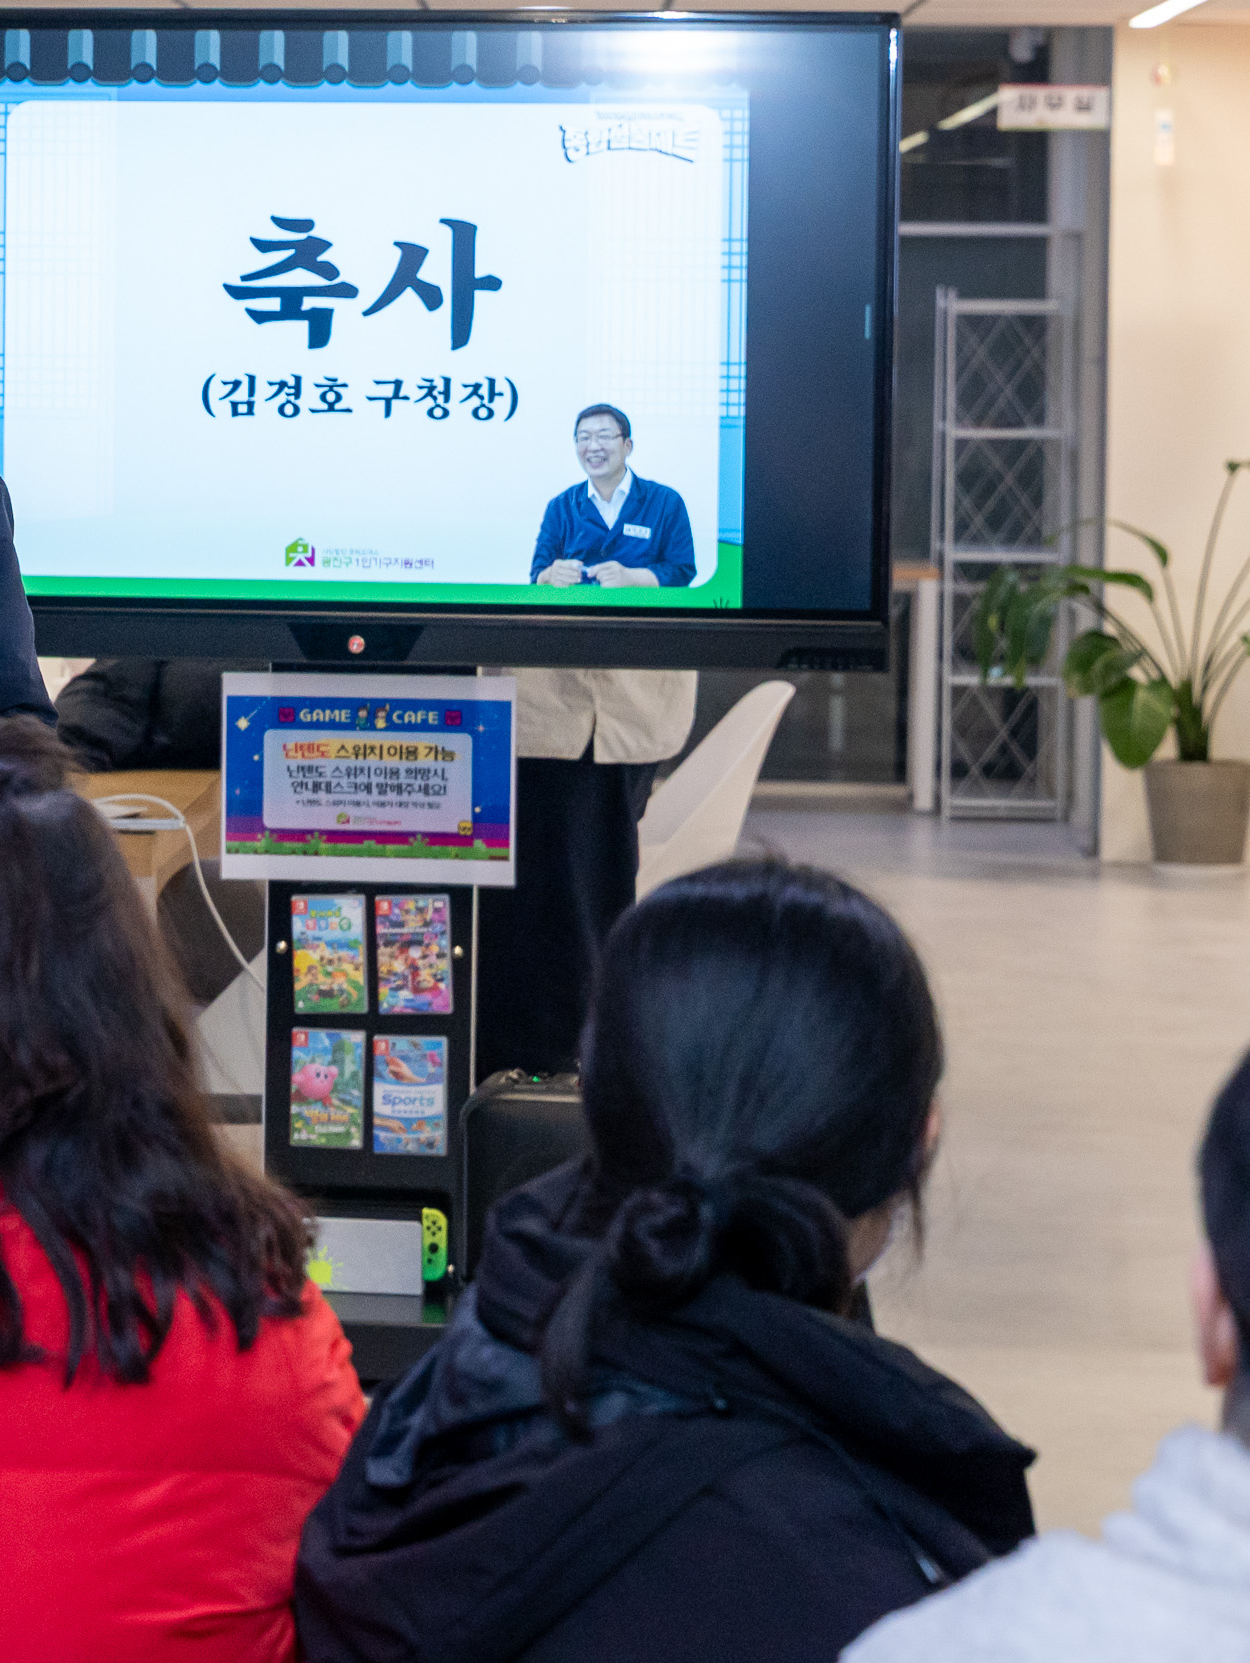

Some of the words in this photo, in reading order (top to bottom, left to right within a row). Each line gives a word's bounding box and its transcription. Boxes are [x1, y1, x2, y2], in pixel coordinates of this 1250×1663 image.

[222, 214, 503, 351] 축사
[201, 372, 353, 418] (김경호
[365, 374, 519, 422] 구청장)
[299, 708, 351, 723] GAME
[392, 710, 439, 725] CAFE
[283, 742, 331, 760] 닌텐도
[334, 743, 383, 761] 스위치
[387, 744, 418, 762] 이용
[287, 765, 327, 779] 닌텐도
[330, 765, 371, 780] 스위치
[373, 766, 401, 780] 이용
[291, 780, 373, 795] 안내데스크에
[375, 781, 448, 797] 말해주세요!
[381, 1093, 436, 1107] Sports
